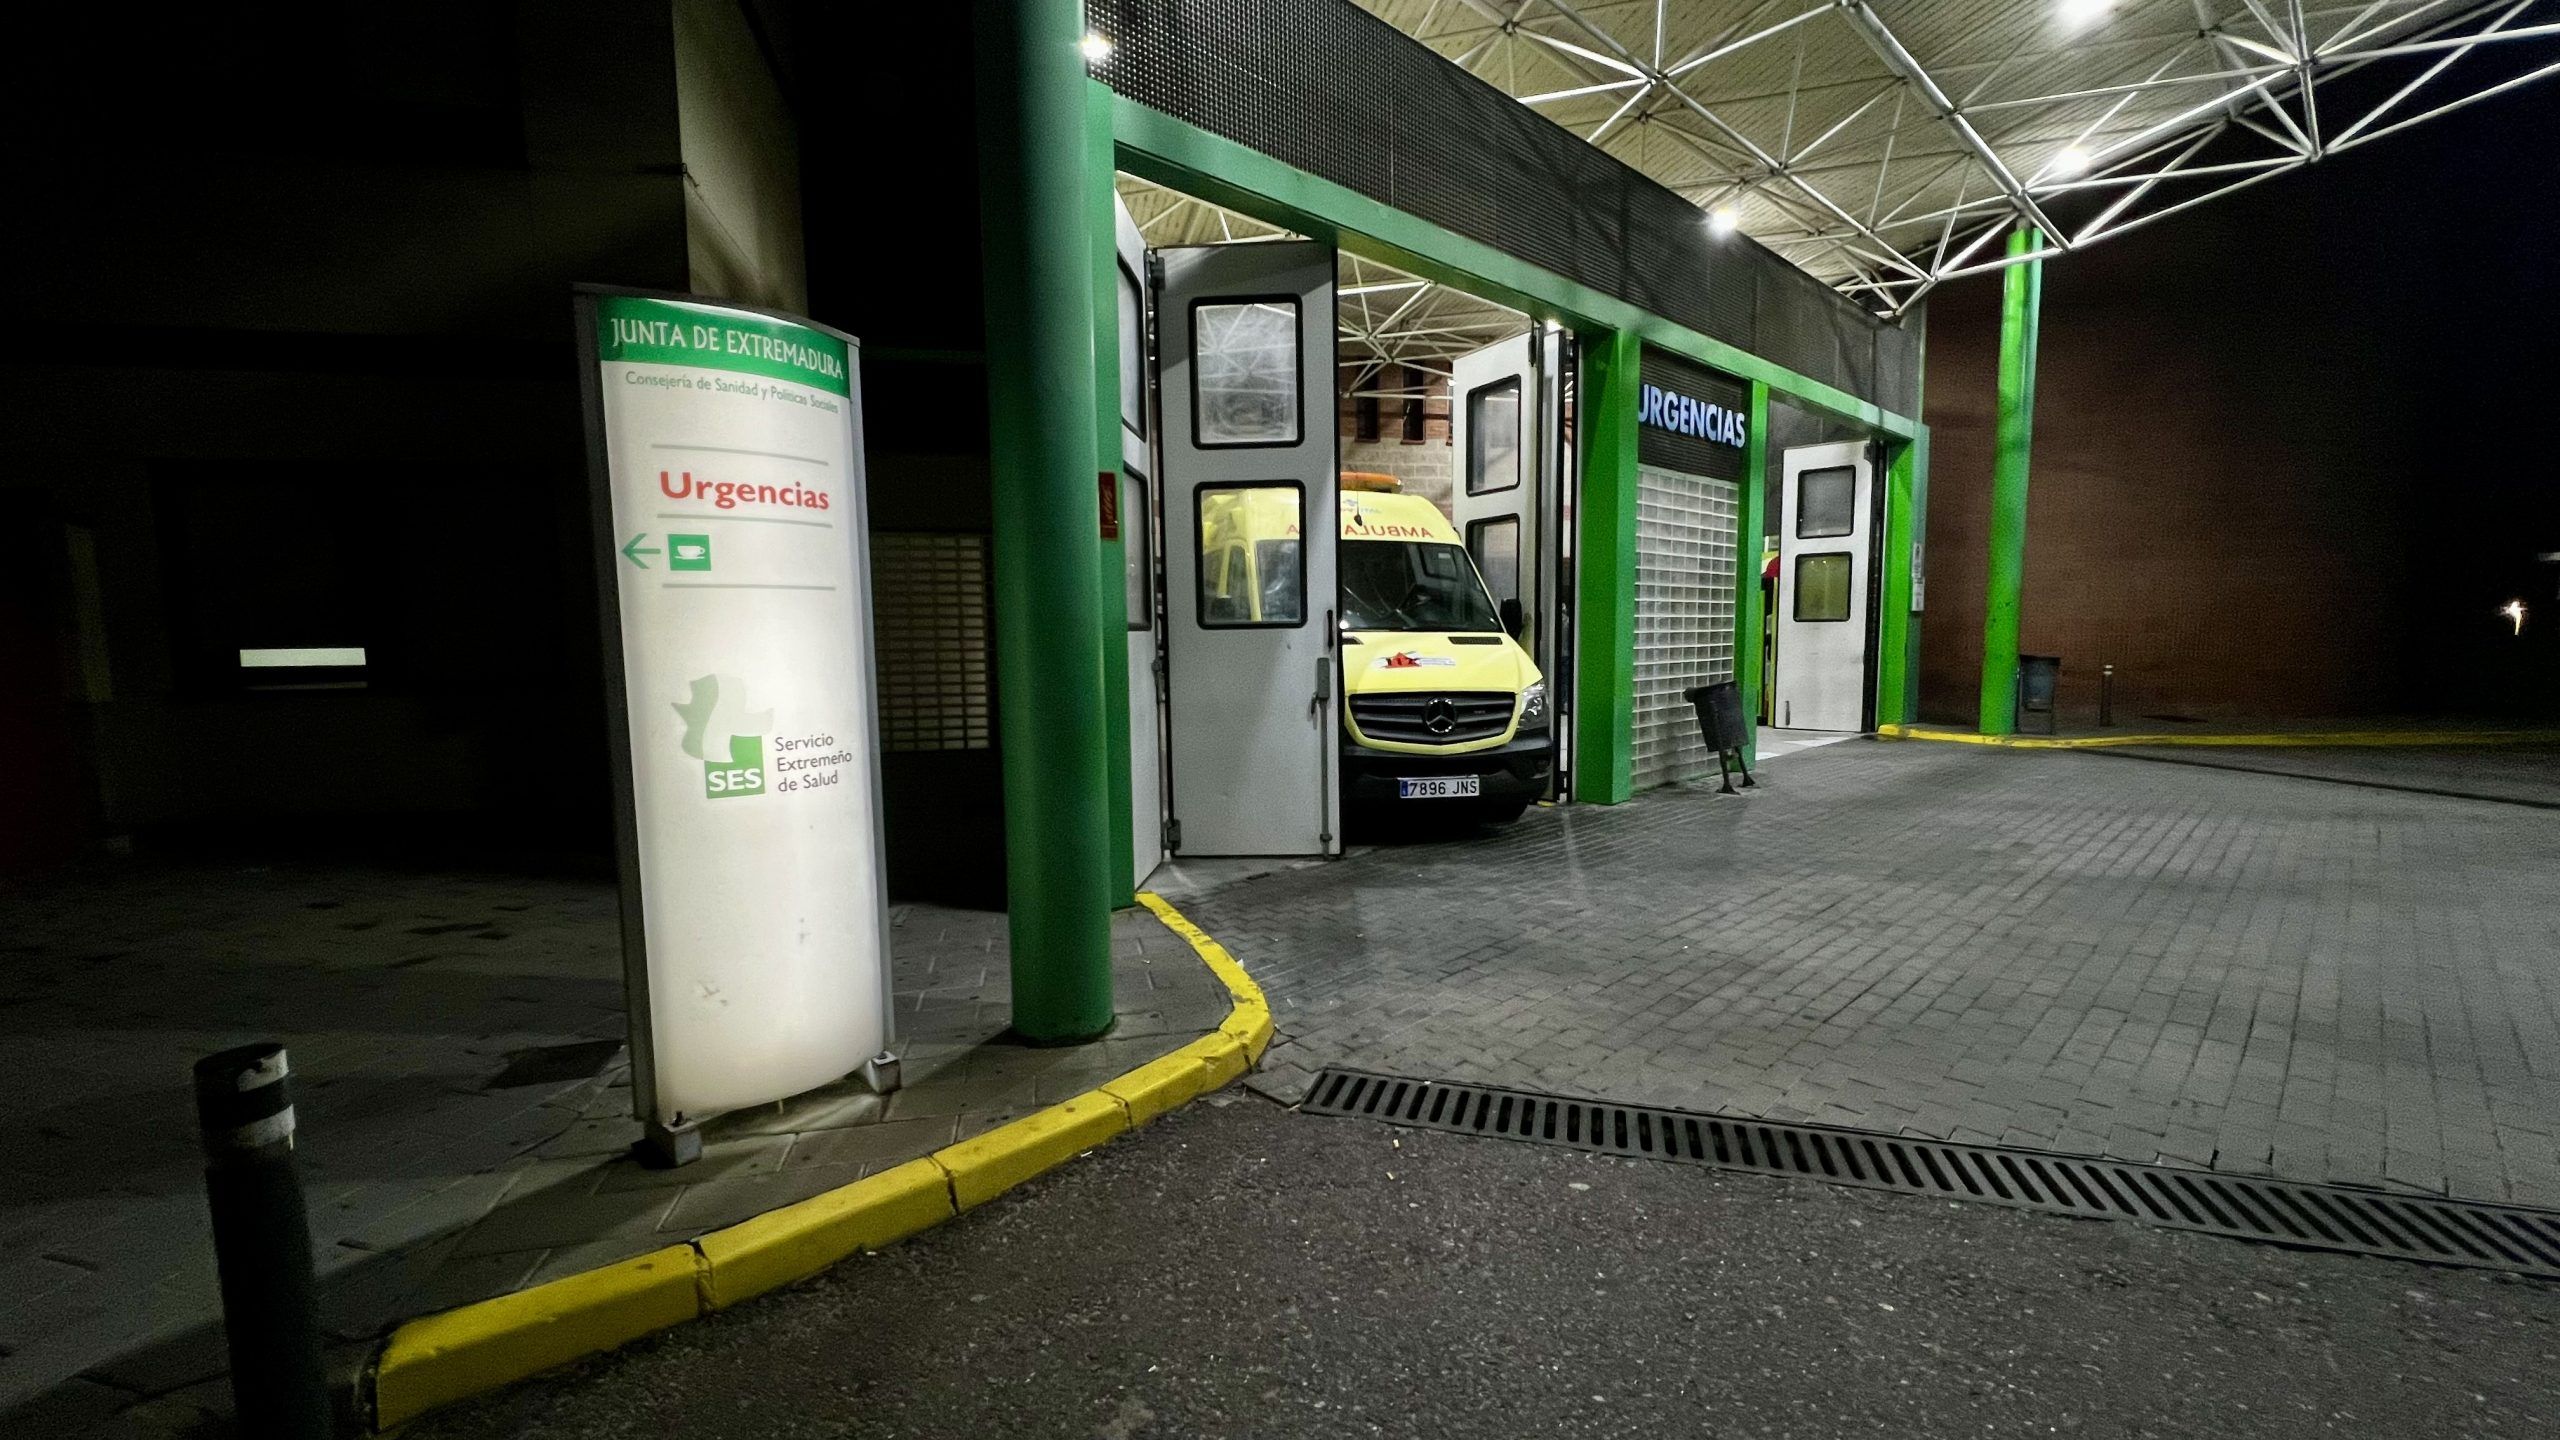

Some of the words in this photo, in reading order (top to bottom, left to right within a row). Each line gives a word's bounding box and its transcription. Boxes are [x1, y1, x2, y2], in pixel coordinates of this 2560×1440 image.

[611, 318, 686, 347] JUNTA
[693, 325, 720, 351] DE
[726, 329, 844, 380] EXTREMADURA
[625, 371, 692, 389] Consejería
[697, 377, 712, 390] de
[715, 378, 759, 396] Sanidad
[761, 386, 767, 400] y
[1638, 384, 1746, 448] URGENCIAS
[660, 471, 830, 510] Urgencias
[775, 733, 834, 752] Servicio
[777, 750, 852, 772] Extremeño
[709, 768, 762, 792] SES
[778, 777, 798, 792] de
[803, 770, 838, 789] Salud
[1408, 782, 1446, 796] 7896
[1452, 780, 1477, 795] JNS
